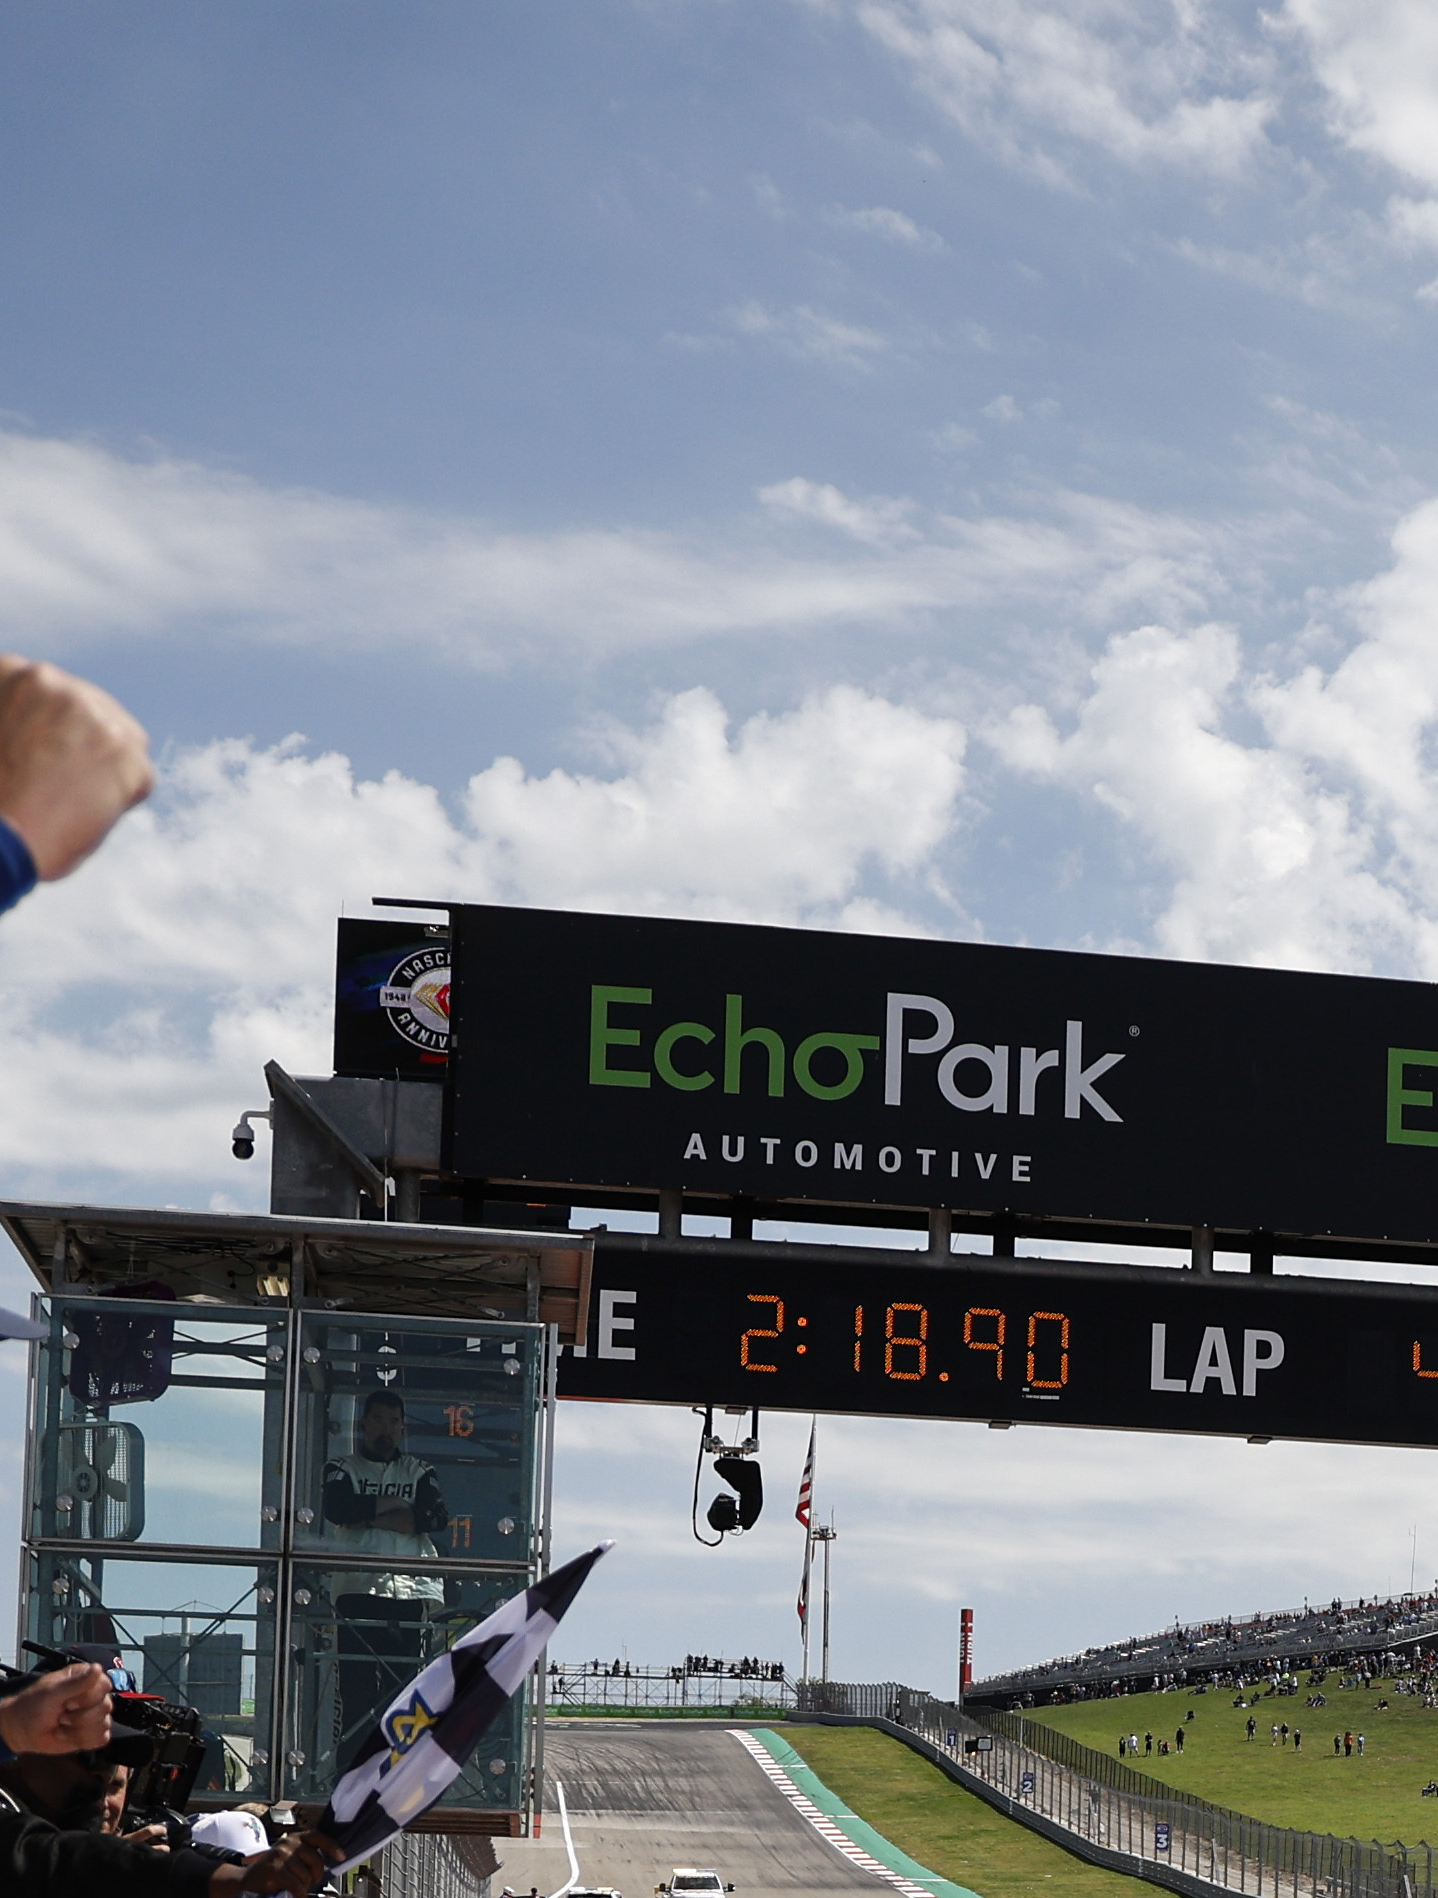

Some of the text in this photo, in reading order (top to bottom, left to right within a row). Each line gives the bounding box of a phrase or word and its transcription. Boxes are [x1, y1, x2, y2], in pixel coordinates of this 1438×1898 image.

[589, 984, 1125, 1123] EchoPark
[683, 1132, 1034, 1184] AUTOMOTIVE
[741, 1293, 1070, 1389] 2:18.90
[1150, 1322, 1286, 1397] LAP
[1022, 1781, 1032, 1793] 2
[1156, 1833, 1169, 1849] 3
